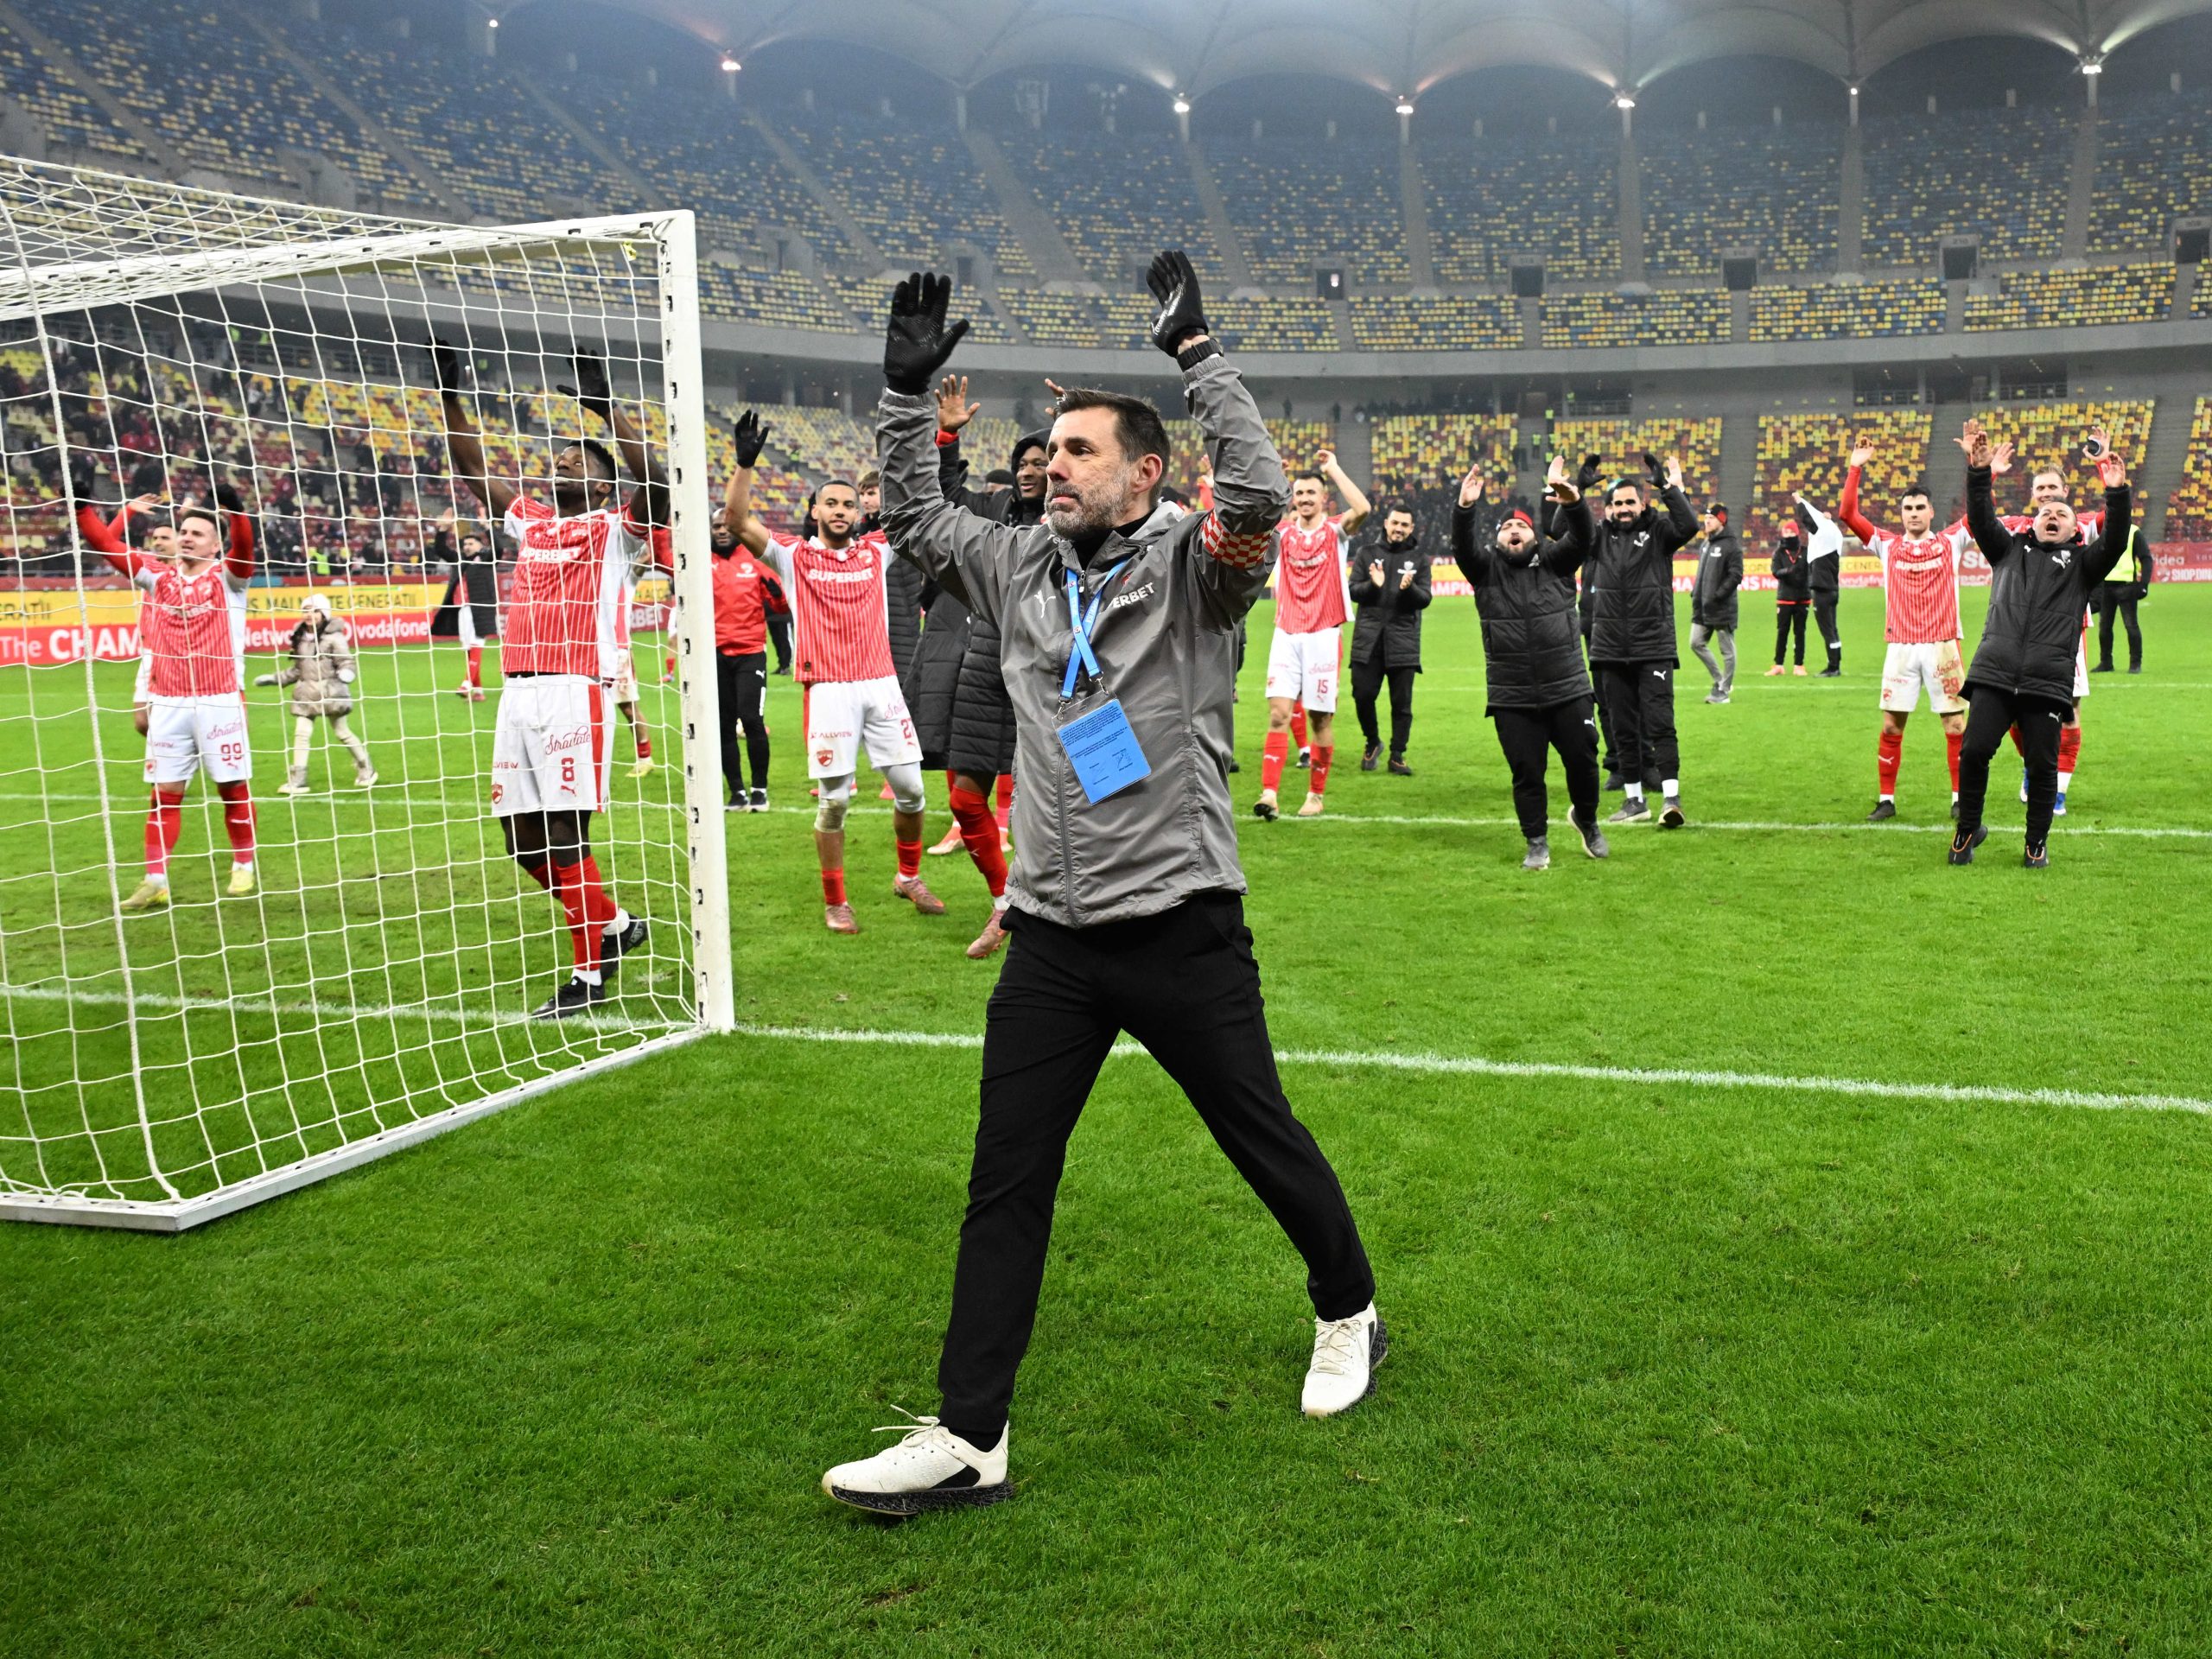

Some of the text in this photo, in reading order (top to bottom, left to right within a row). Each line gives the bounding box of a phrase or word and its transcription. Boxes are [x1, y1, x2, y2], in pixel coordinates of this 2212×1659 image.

[808, 568, 874, 583] SUPERBET
[1111, 582, 1155, 608] ERBET
[356, 617, 429, 640] vodafone
[0, 635, 42, 658] The
[1317, 679, 1329, 694] 15
[220, 743, 243, 761] 99
[561, 757, 575, 782] 8
